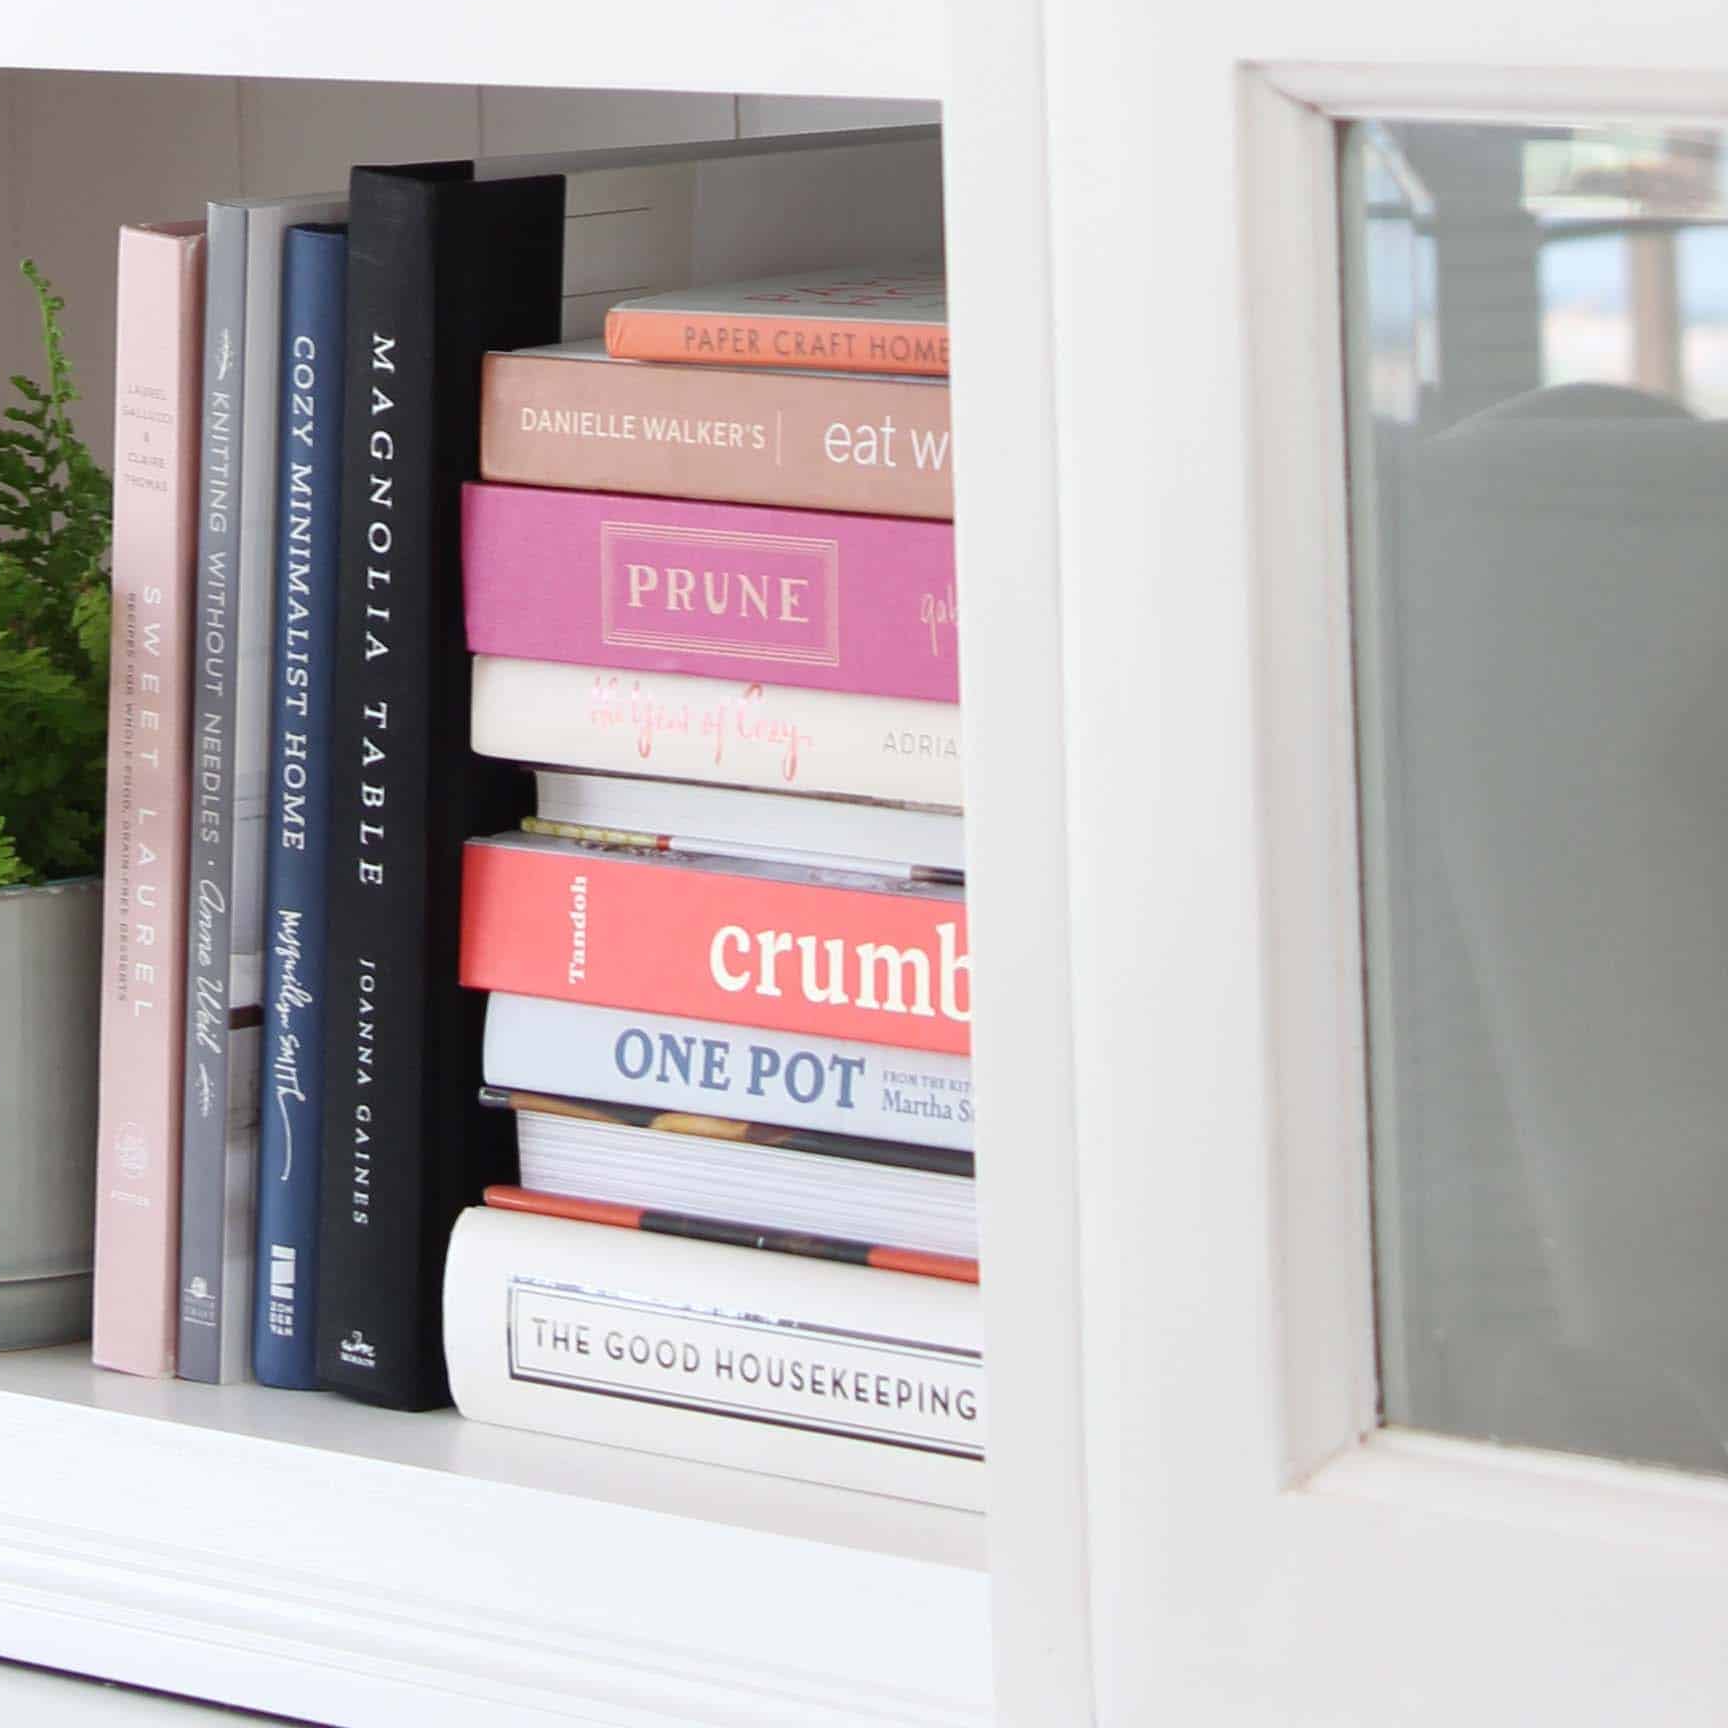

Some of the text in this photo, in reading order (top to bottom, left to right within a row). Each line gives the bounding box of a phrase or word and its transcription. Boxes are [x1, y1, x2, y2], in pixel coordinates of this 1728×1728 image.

[684, 326, 949, 362] PAPER CRAFT HOME
[520, 407, 896, 467] DANIELLE WALKER'S eat
[282, 334, 317, 850] COZY MINIMALIST HOME
[624, 563, 810, 624] PRUNE
[195, 390, 233, 967] KNITTING WITHOUT NEEDLES Anne
[134, 585, 162, 1019] SWEET LAUREL
[352, 332, 396, 1226] MAGNOLIA TABLE JOANNA GAINES
[568, 875, 588, 985] Tandoh
[615, 1027, 866, 1110] ONE POT
[882, 1088, 952, 1120] Martha
[883, 1070, 945, 1089] FROM THE
[530, 1316, 979, 1422] THE GOOD HOUSEKEEPING
